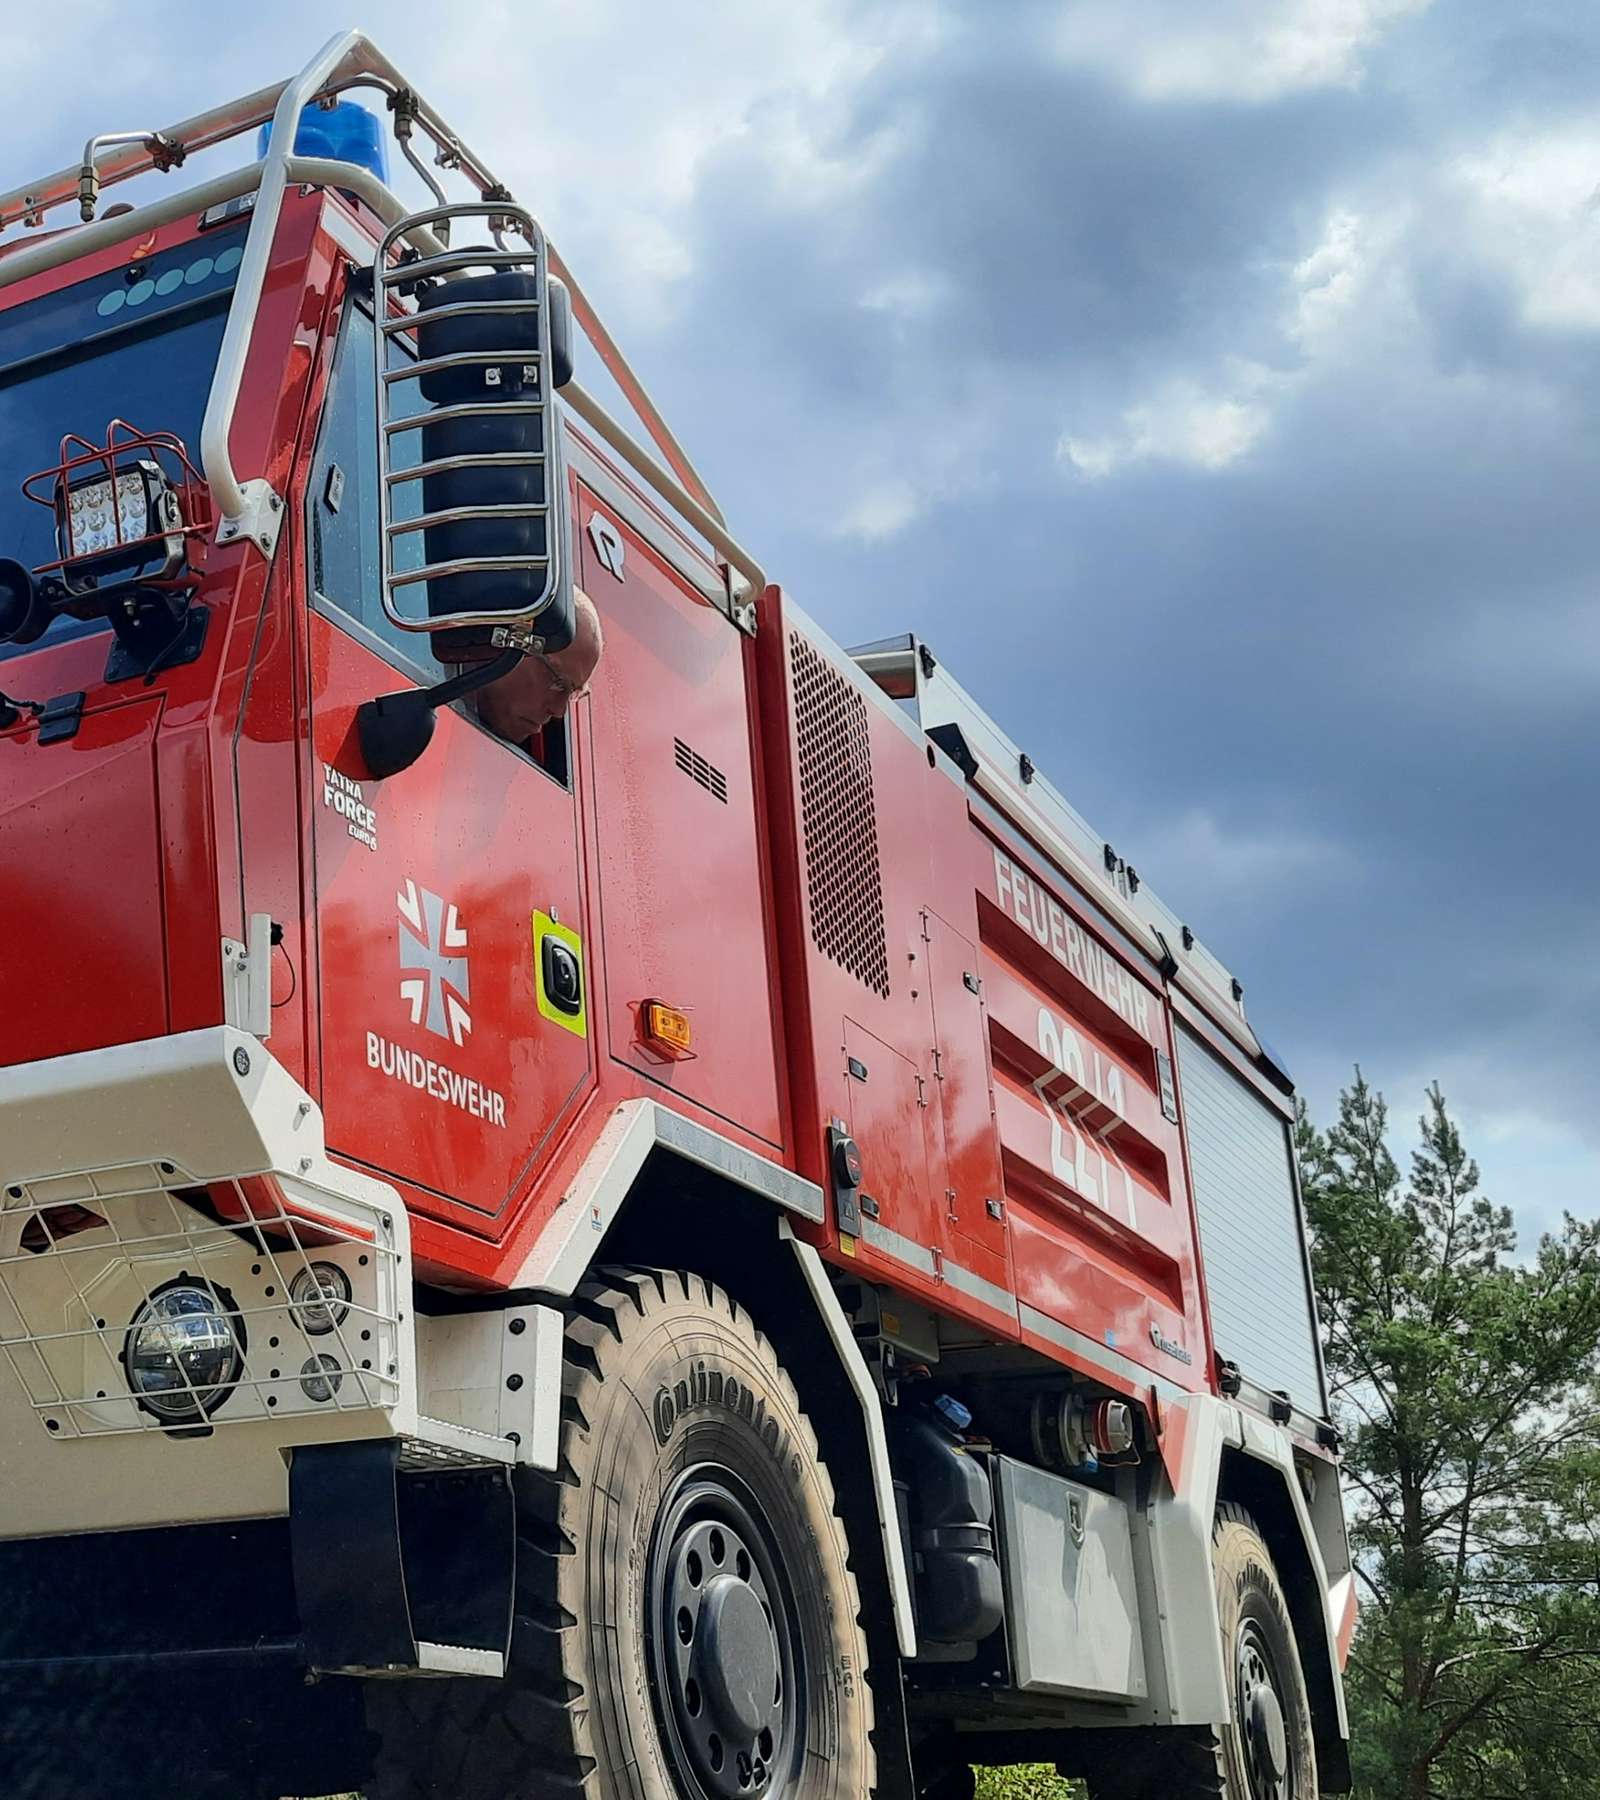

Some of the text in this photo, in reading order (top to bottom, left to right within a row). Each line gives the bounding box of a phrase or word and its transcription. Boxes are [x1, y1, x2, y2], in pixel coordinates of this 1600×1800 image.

[323, 761, 362, 801] TATRA
[324, 783, 377, 834] FORCE
[992, 846, 1150, 1040] FEUERWEHR
[366, 1031, 507, 1129] BUNDESWEHR
[653, 1361, 792, 1467] Continental
